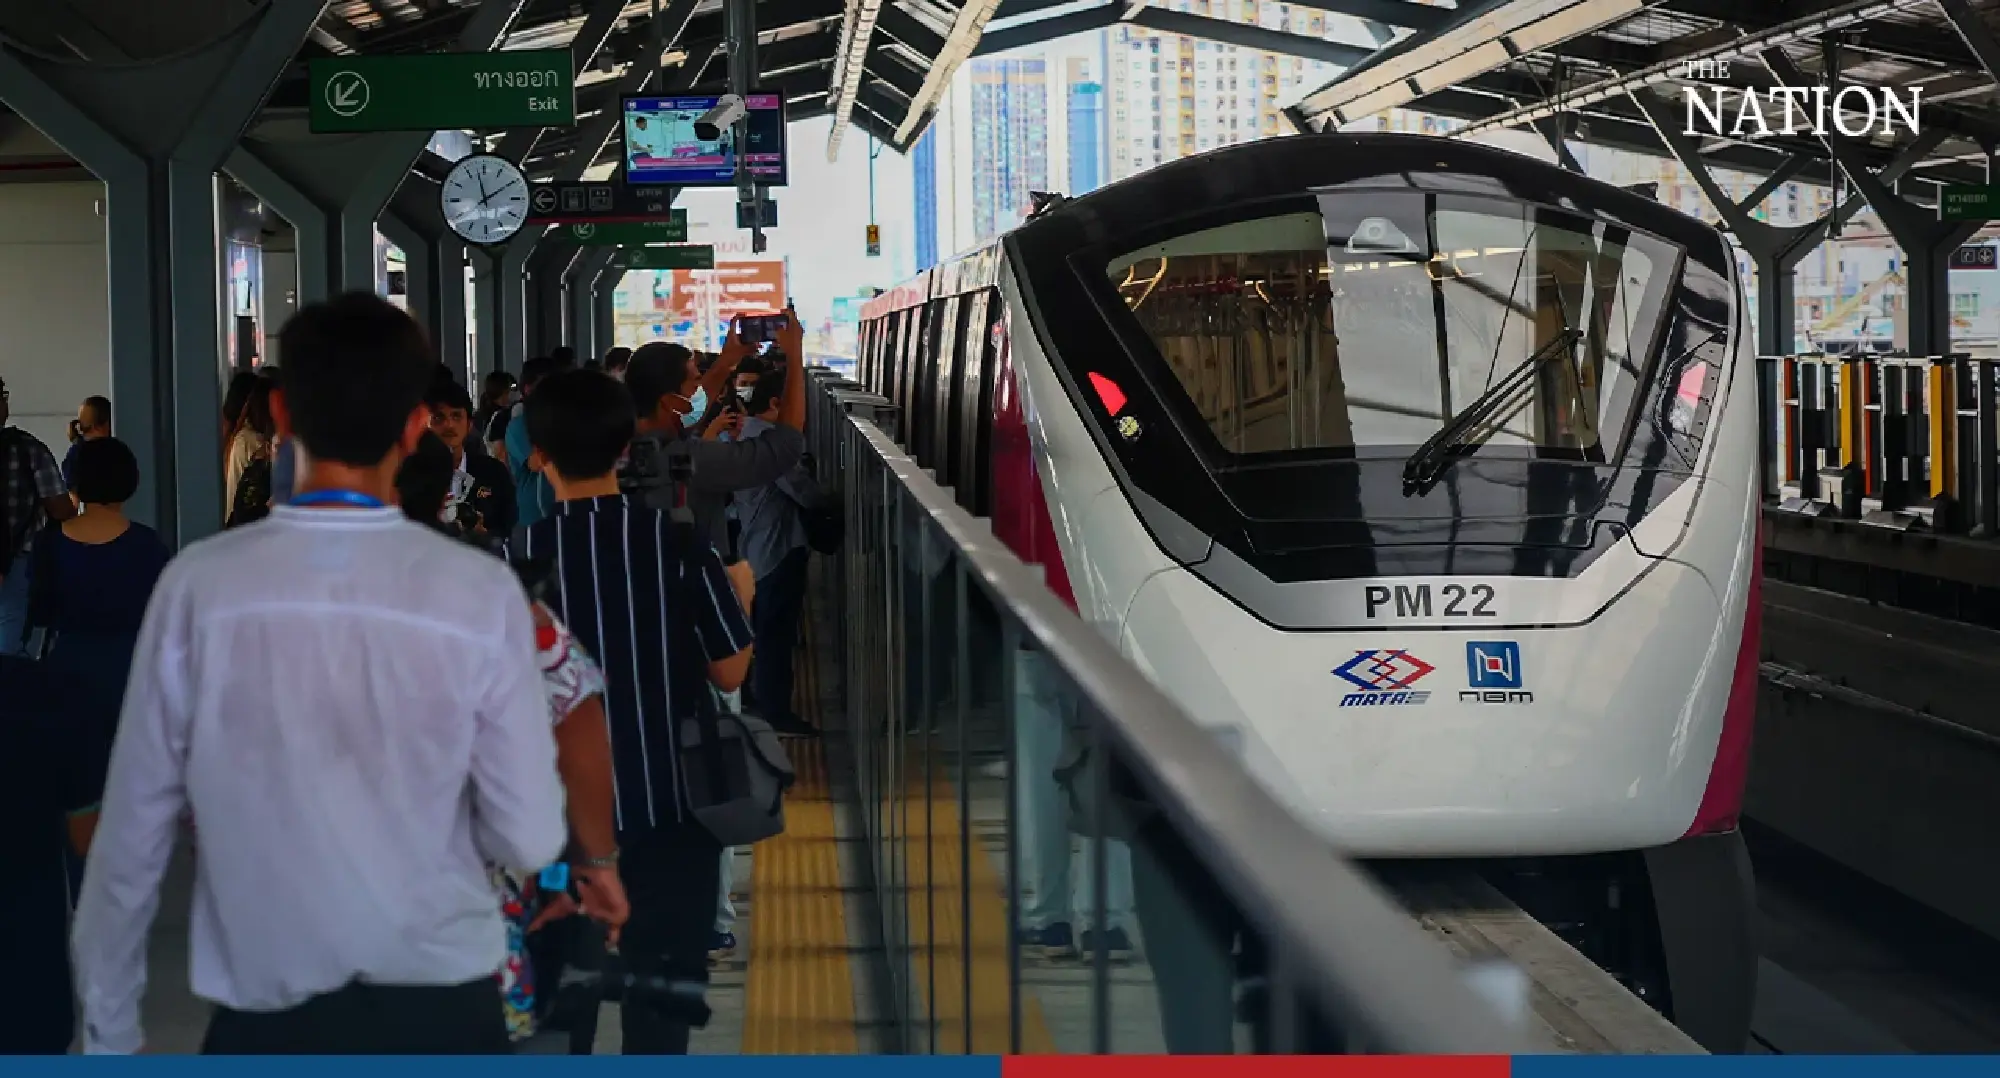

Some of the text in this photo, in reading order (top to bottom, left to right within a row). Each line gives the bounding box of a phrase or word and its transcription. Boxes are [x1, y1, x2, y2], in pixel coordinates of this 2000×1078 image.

[473, 70, 559, 88] ทางออก
[528, 96, 559, 111] Exit
[1364, 583, 1498, 619] PM 22
